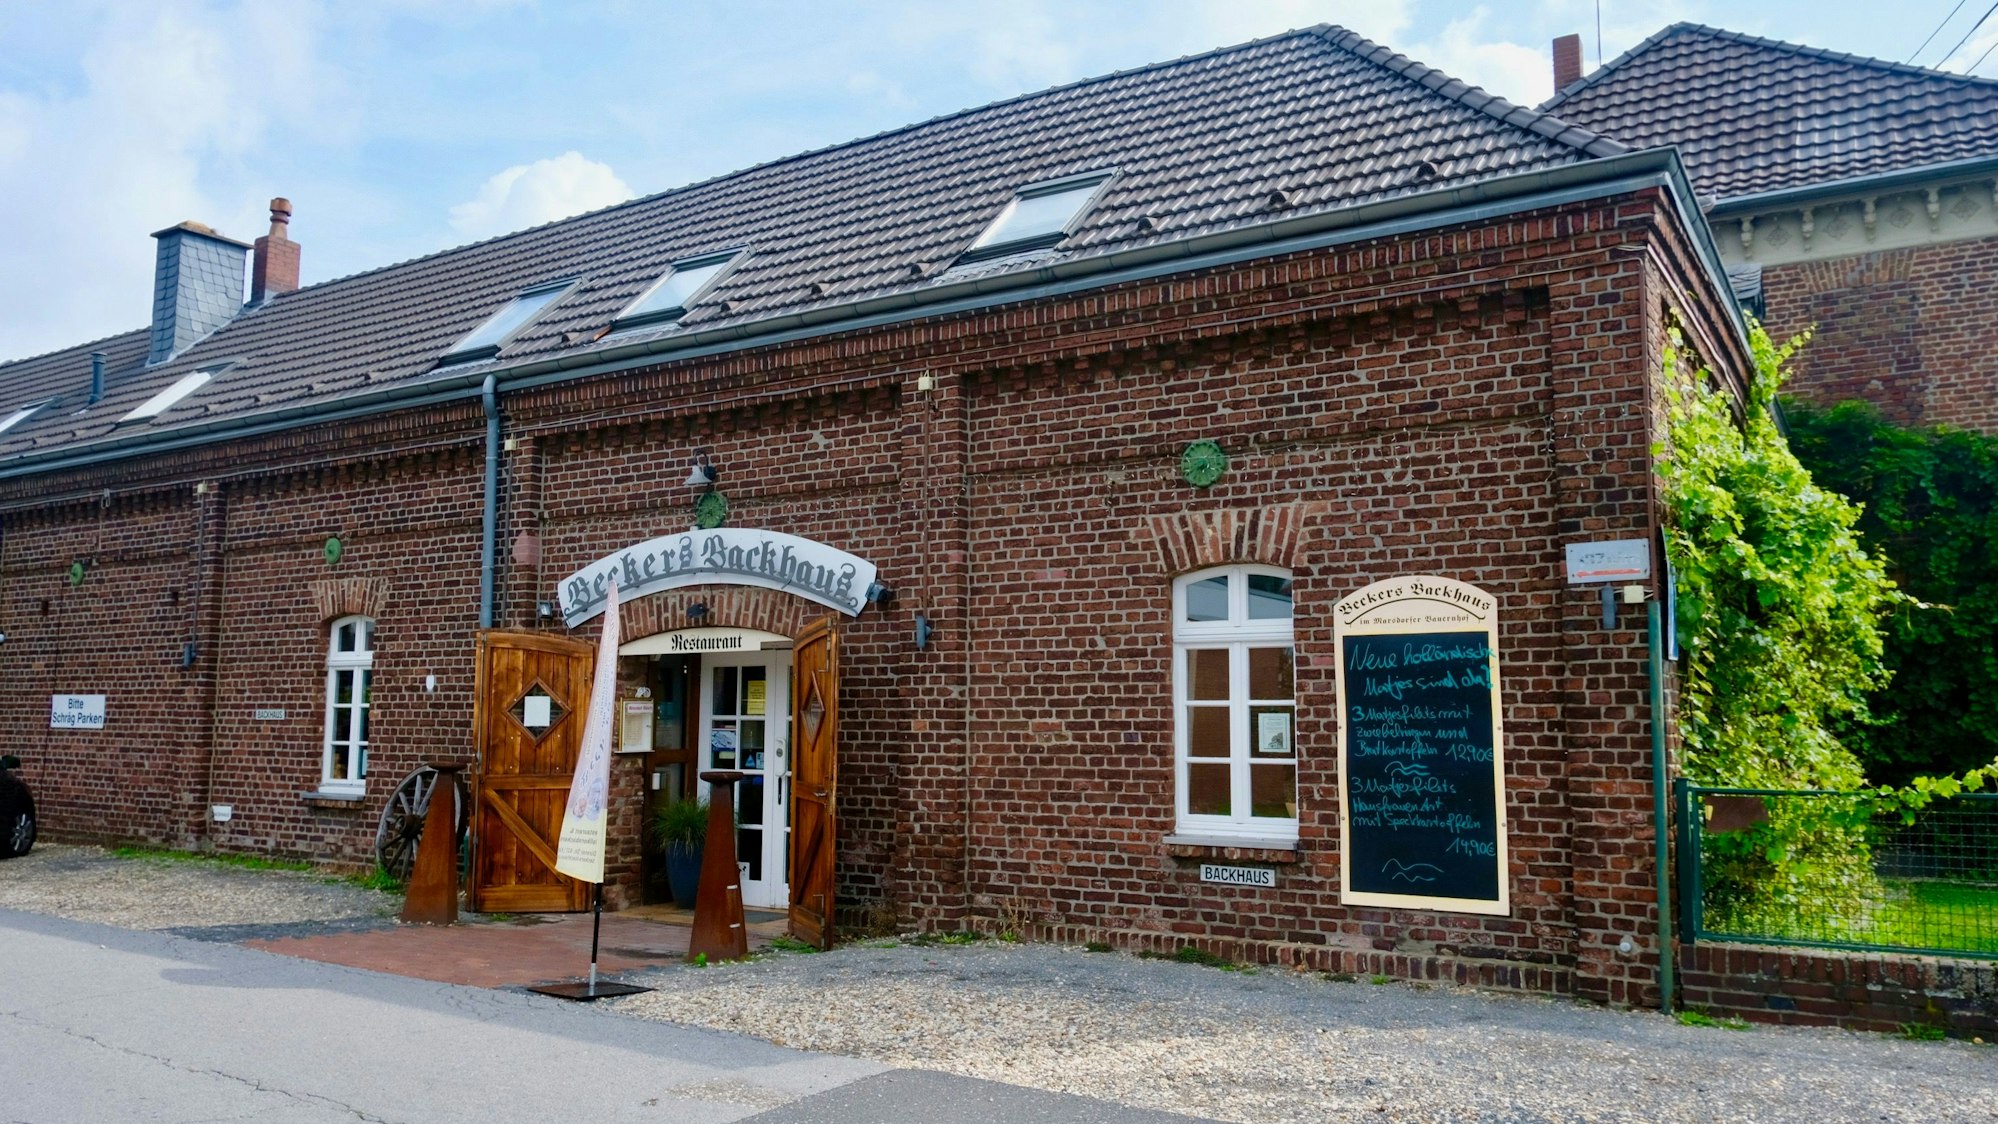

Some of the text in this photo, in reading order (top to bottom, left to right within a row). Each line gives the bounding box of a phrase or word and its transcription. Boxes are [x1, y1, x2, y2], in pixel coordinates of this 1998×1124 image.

[567, 534, 858, 608] Beckers Backhaus
[1338, 582, 1492, 615] Beckers Backhaus
[1424, 614, 1469, 623] Bauernhof
[671, 633, 742, 651] Restaurant
[1350, 643, 1397, 671] Neue
[1364, 674, 1413, 700] Matjes
[1416, 669, 1460, 690] sind
[68, 698, 84, 709] Bitte
[52, 711, 103, 726] Schräg Parken
[257, 711, 283, 719] BACKHAUS
[1352, 705, 1365, 722] 3
[1437, 704, 1473, 719] mit
[1434, 726, 1469, 740] und
[1351, 776, 1457, 799] 3 Matjesfilets
[1419, 798, 1444, 812] Art
[1352, 812, 1382, 827] mit
[1204, 866, 1270, 884] BACKHAUS
